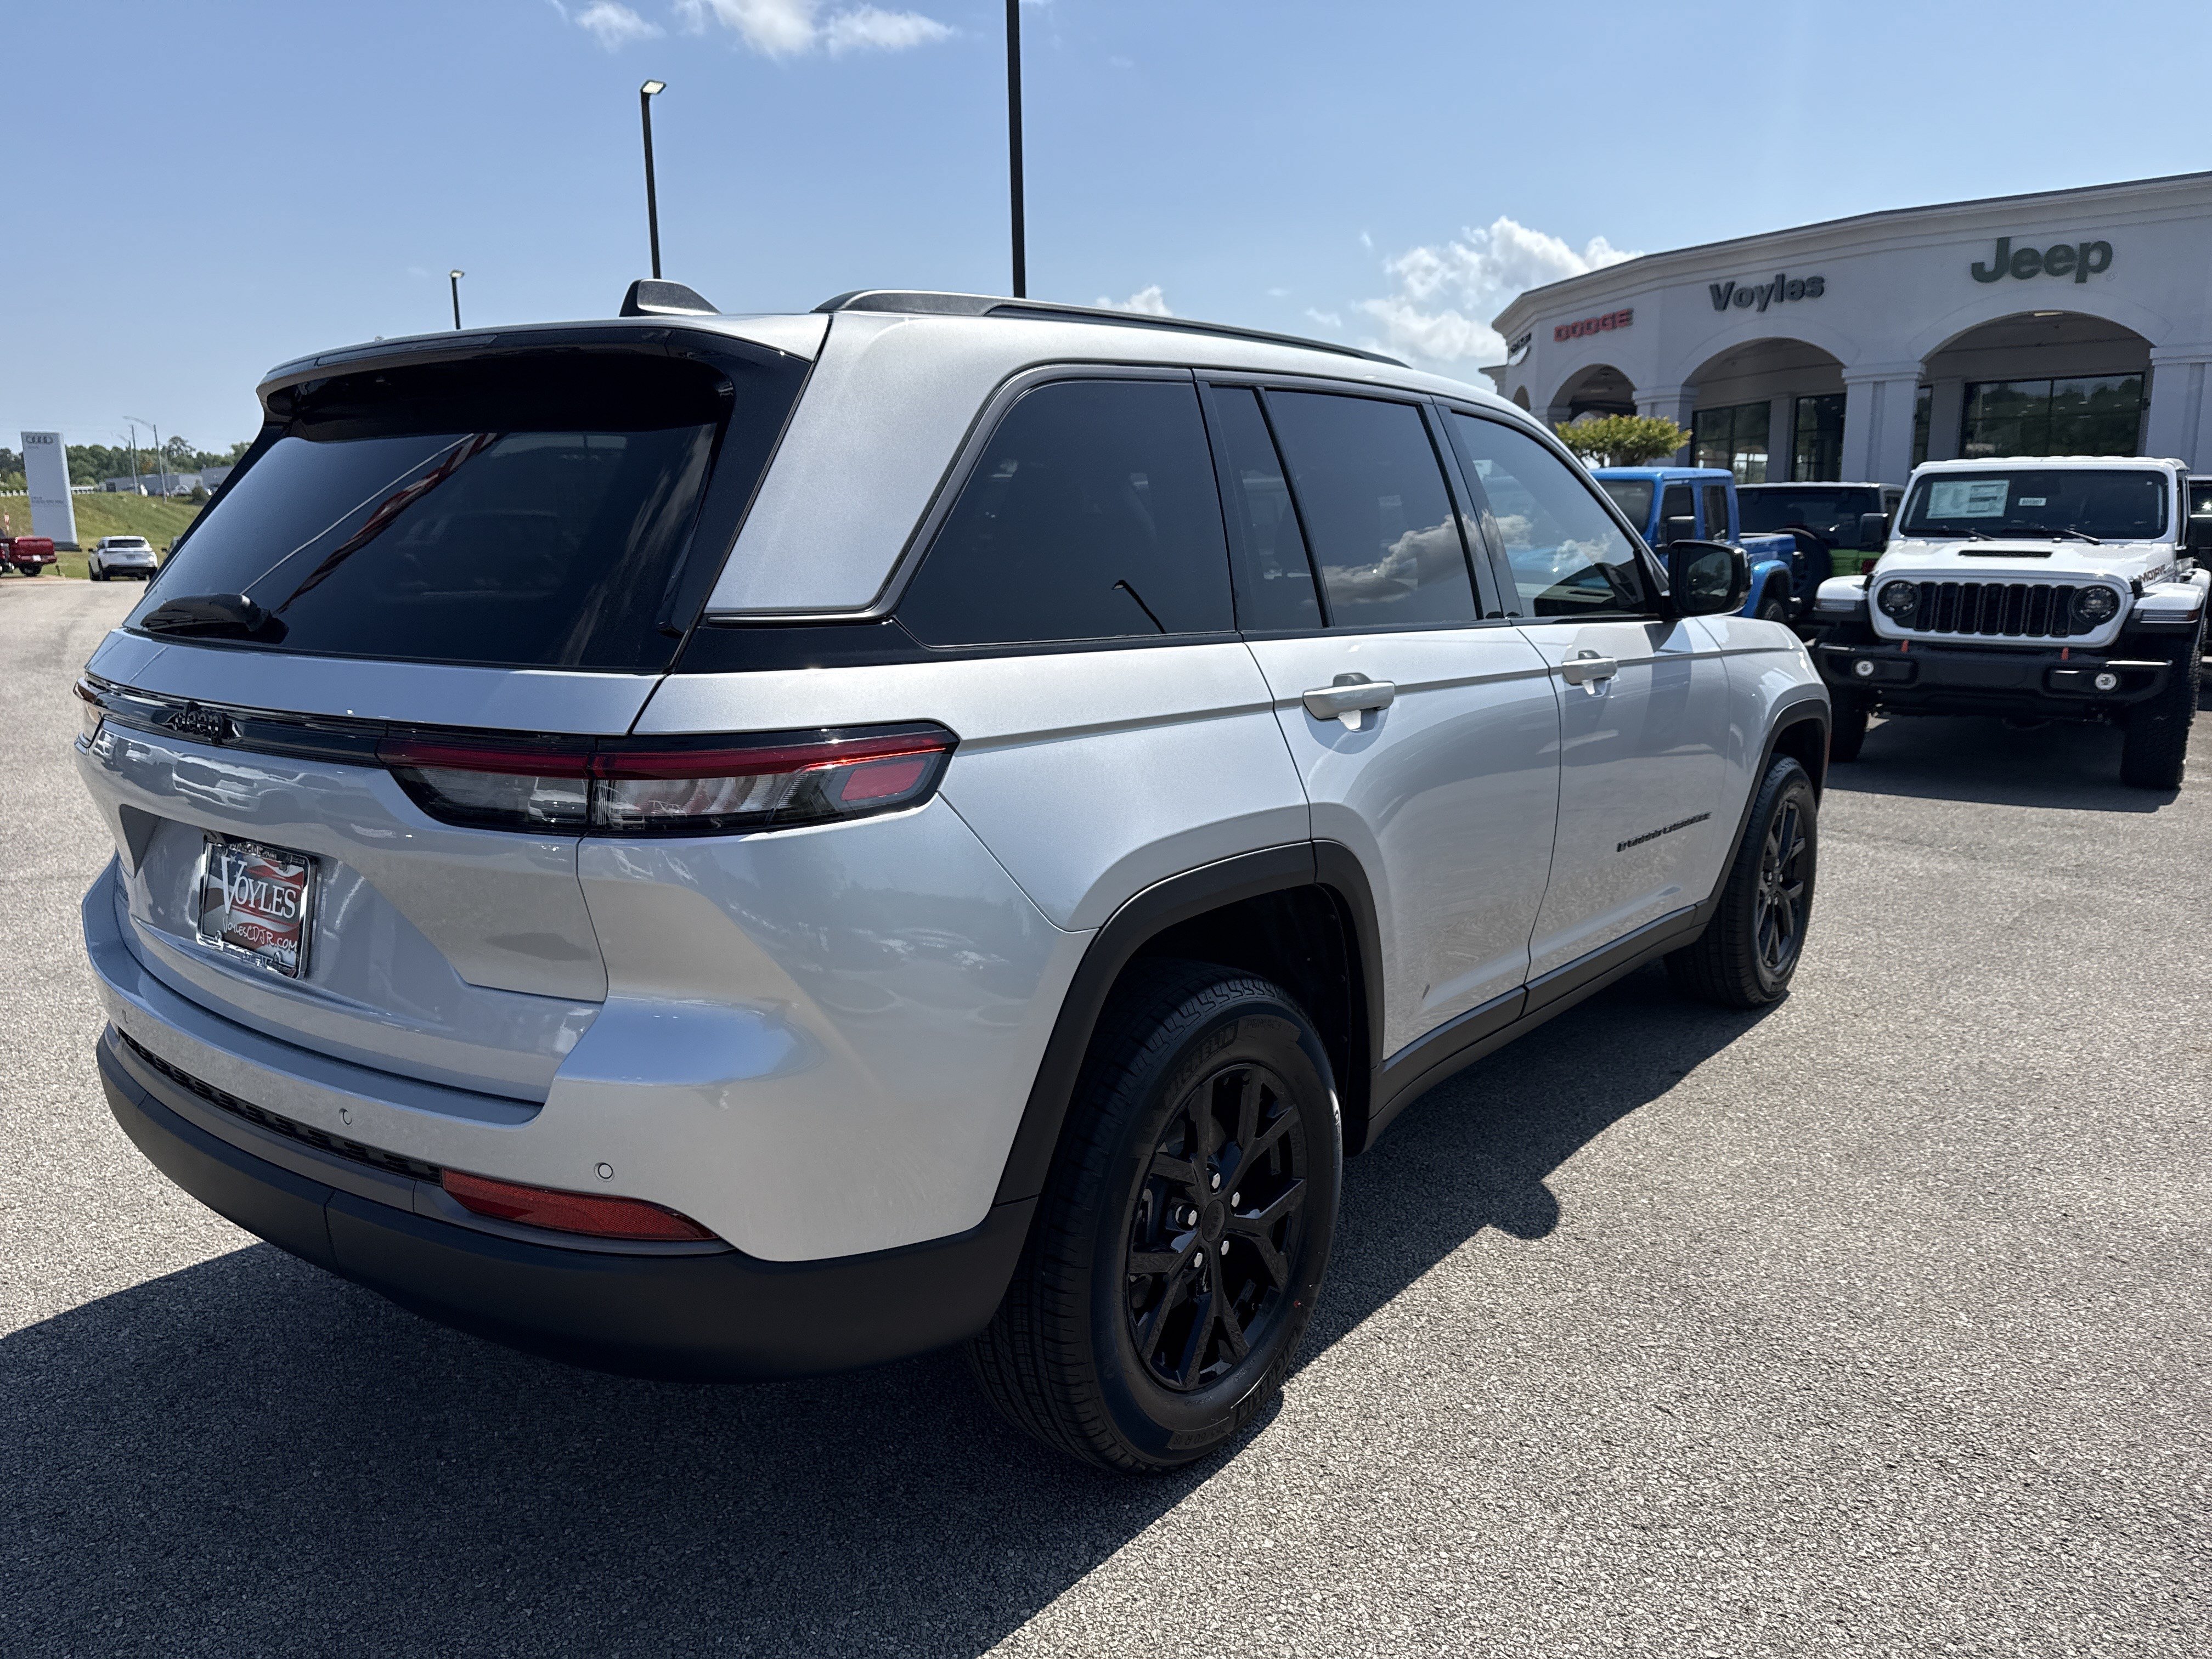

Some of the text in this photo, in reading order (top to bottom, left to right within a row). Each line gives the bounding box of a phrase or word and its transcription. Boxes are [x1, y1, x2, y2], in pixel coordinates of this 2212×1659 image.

[1971, 236, 2113, 284] Jeep
[1709, 273, 1825, 312] Voyles
[1554, 308, 1634, 342] DODGE
[221, 856, 296, 918] VOYLES
